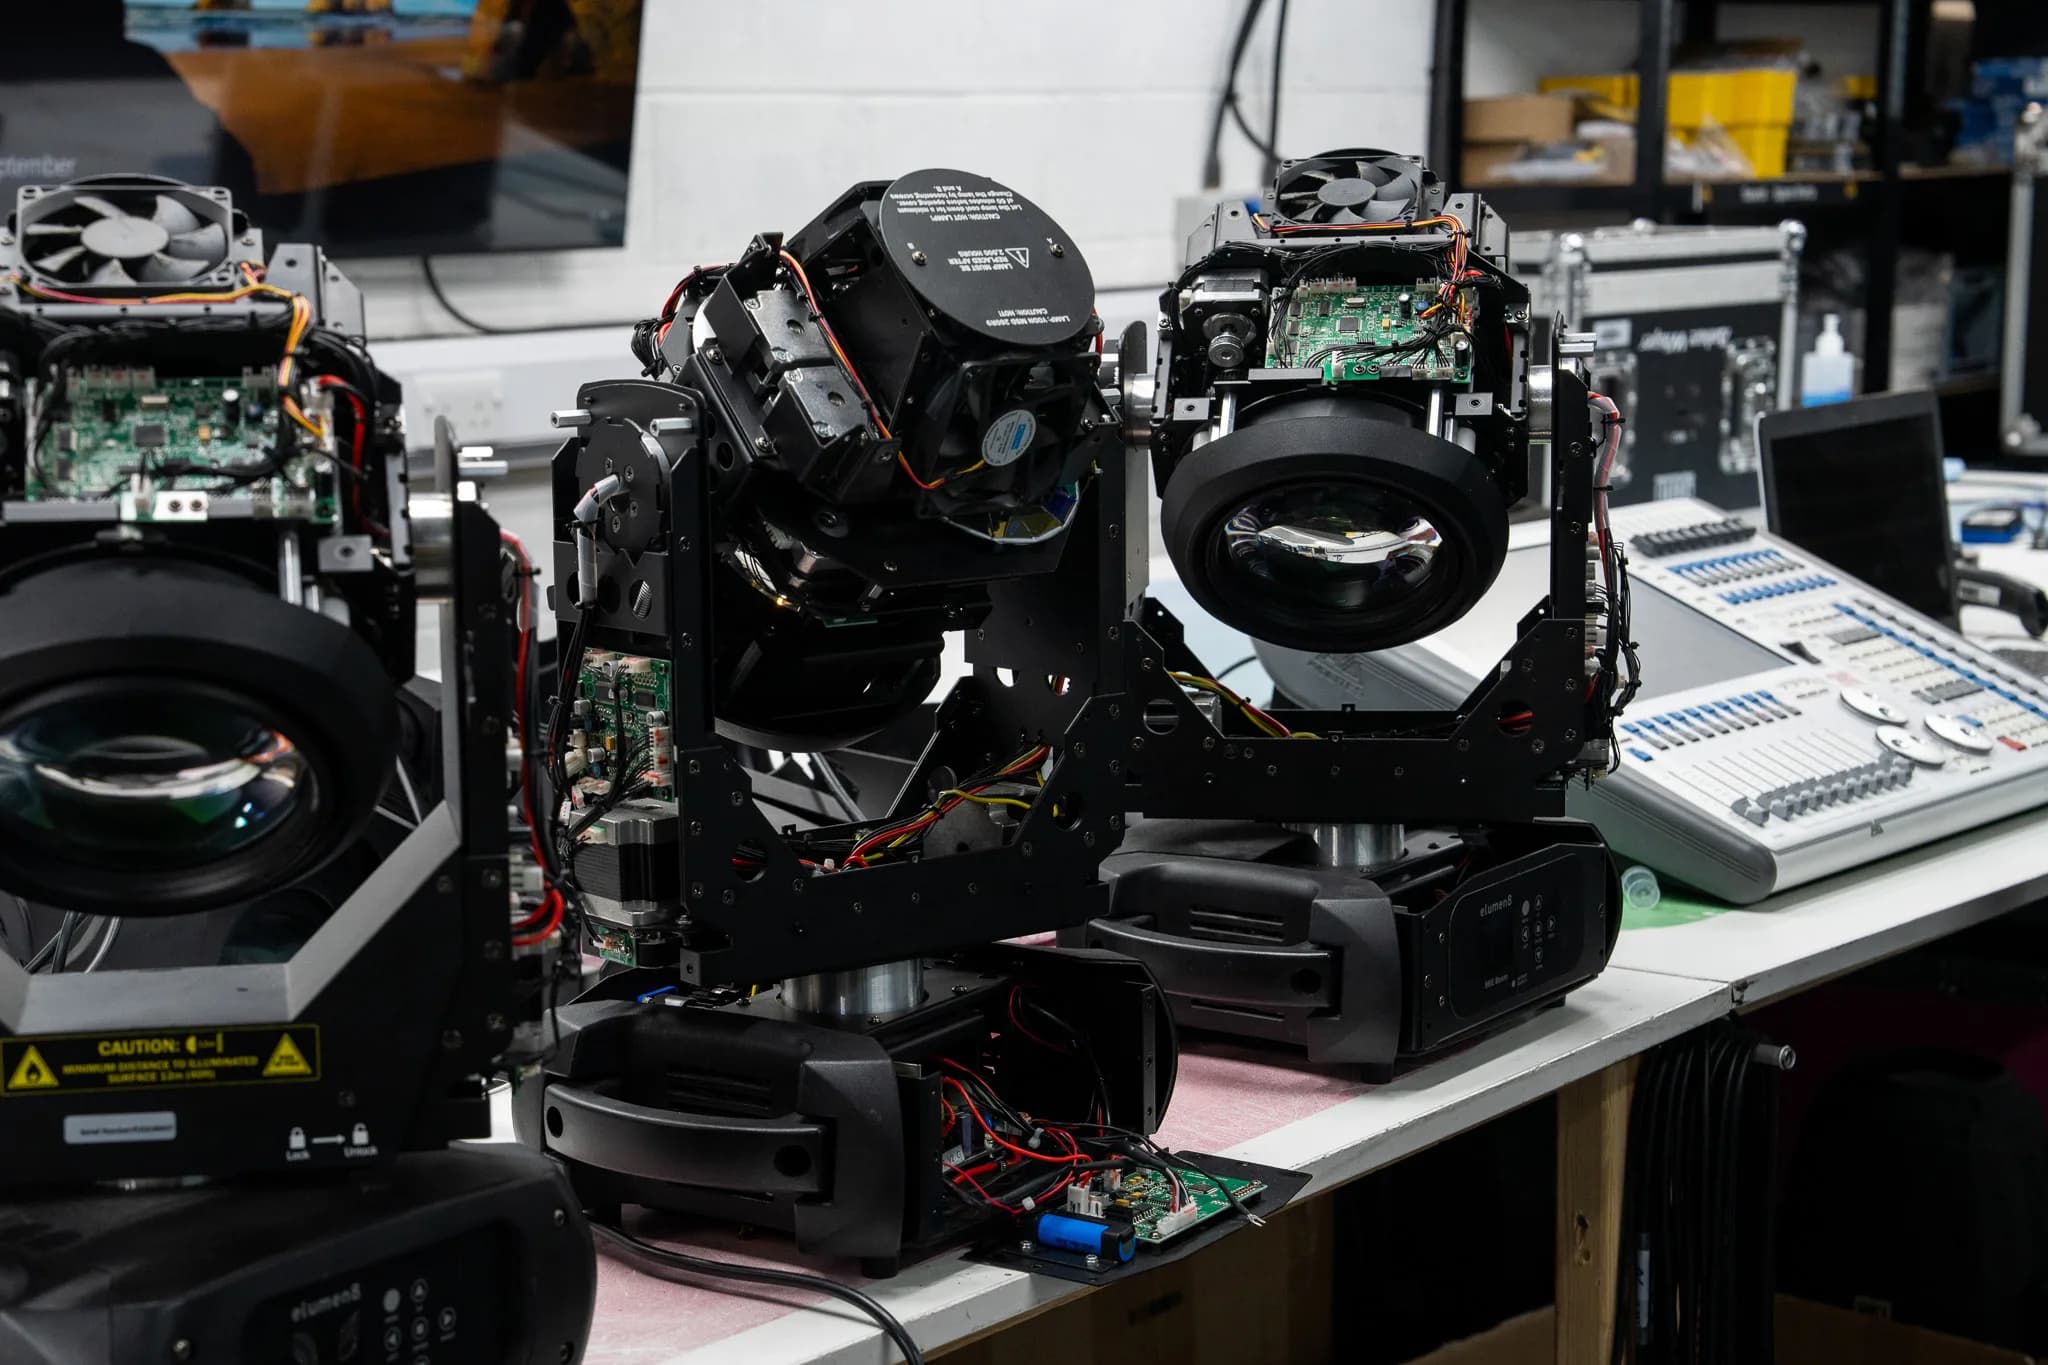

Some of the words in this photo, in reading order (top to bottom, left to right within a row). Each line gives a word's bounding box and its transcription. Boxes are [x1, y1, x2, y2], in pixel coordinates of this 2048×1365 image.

[987, 190, 1012, 198] Change
[936, 206, 946, 214] for
[980, 204, 998, 212] lamp
[998, 204, 1010, 212] the
[958, 250, 984, 258] HOURS
[972, 256, 1008, 264] REPLACED
[960, 264, 972, 272] BE
[971, 264, 992, 272] MUST
[98, 1038, 181, 1057] CAUTION:
[62, 1063, 117, 1074] MINIMUM
[118, 1060, 169, 1072] DISTANCE
[172, 1059, 187, 1069] TO
[188, 1056, 259, 1068] ILLUMINATED
[107, 1072, 157, 1084] SURFACE
[285, 1150, 310, 1161] Lock
[343, 1145, 379, 1158] Unlock
